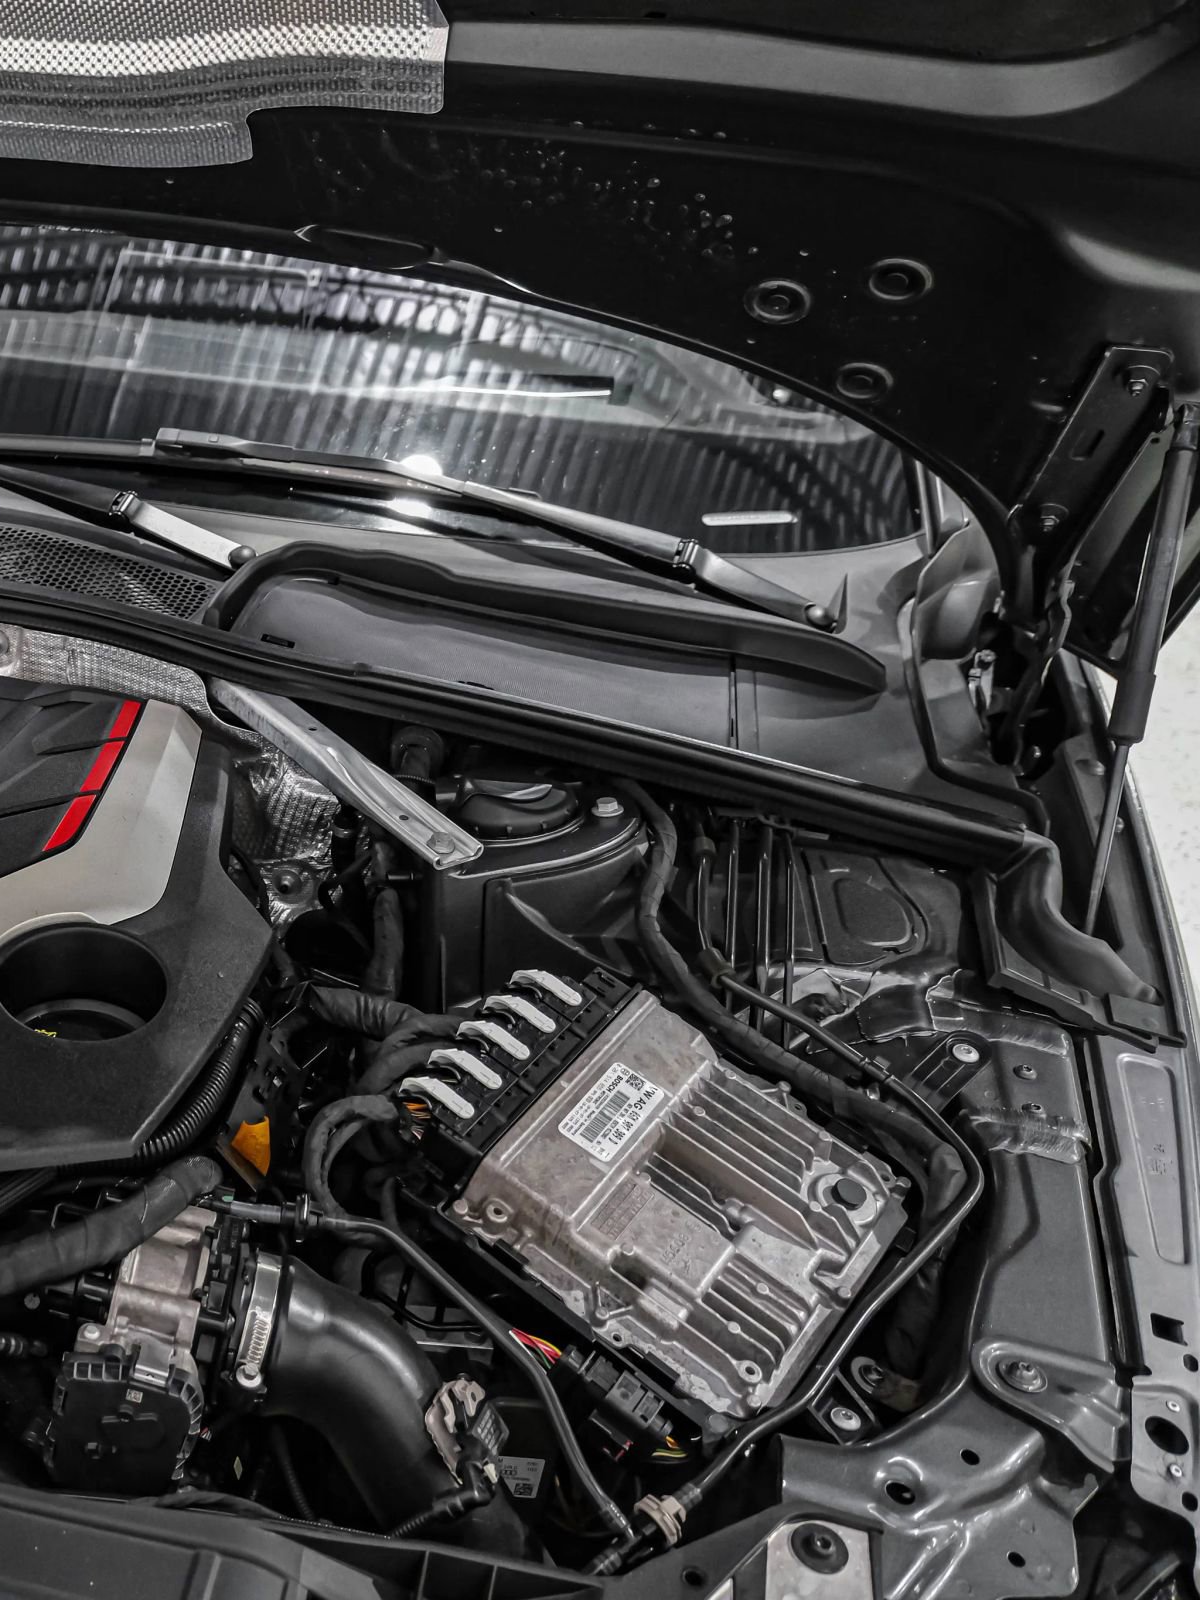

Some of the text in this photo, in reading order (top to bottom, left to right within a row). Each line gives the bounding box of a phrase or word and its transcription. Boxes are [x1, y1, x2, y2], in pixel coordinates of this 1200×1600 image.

[606, 1074, 624, 1093] BOSCH
[643, 1084, 658, 1100] VW
[633, 1097, 648, 1111] AG
